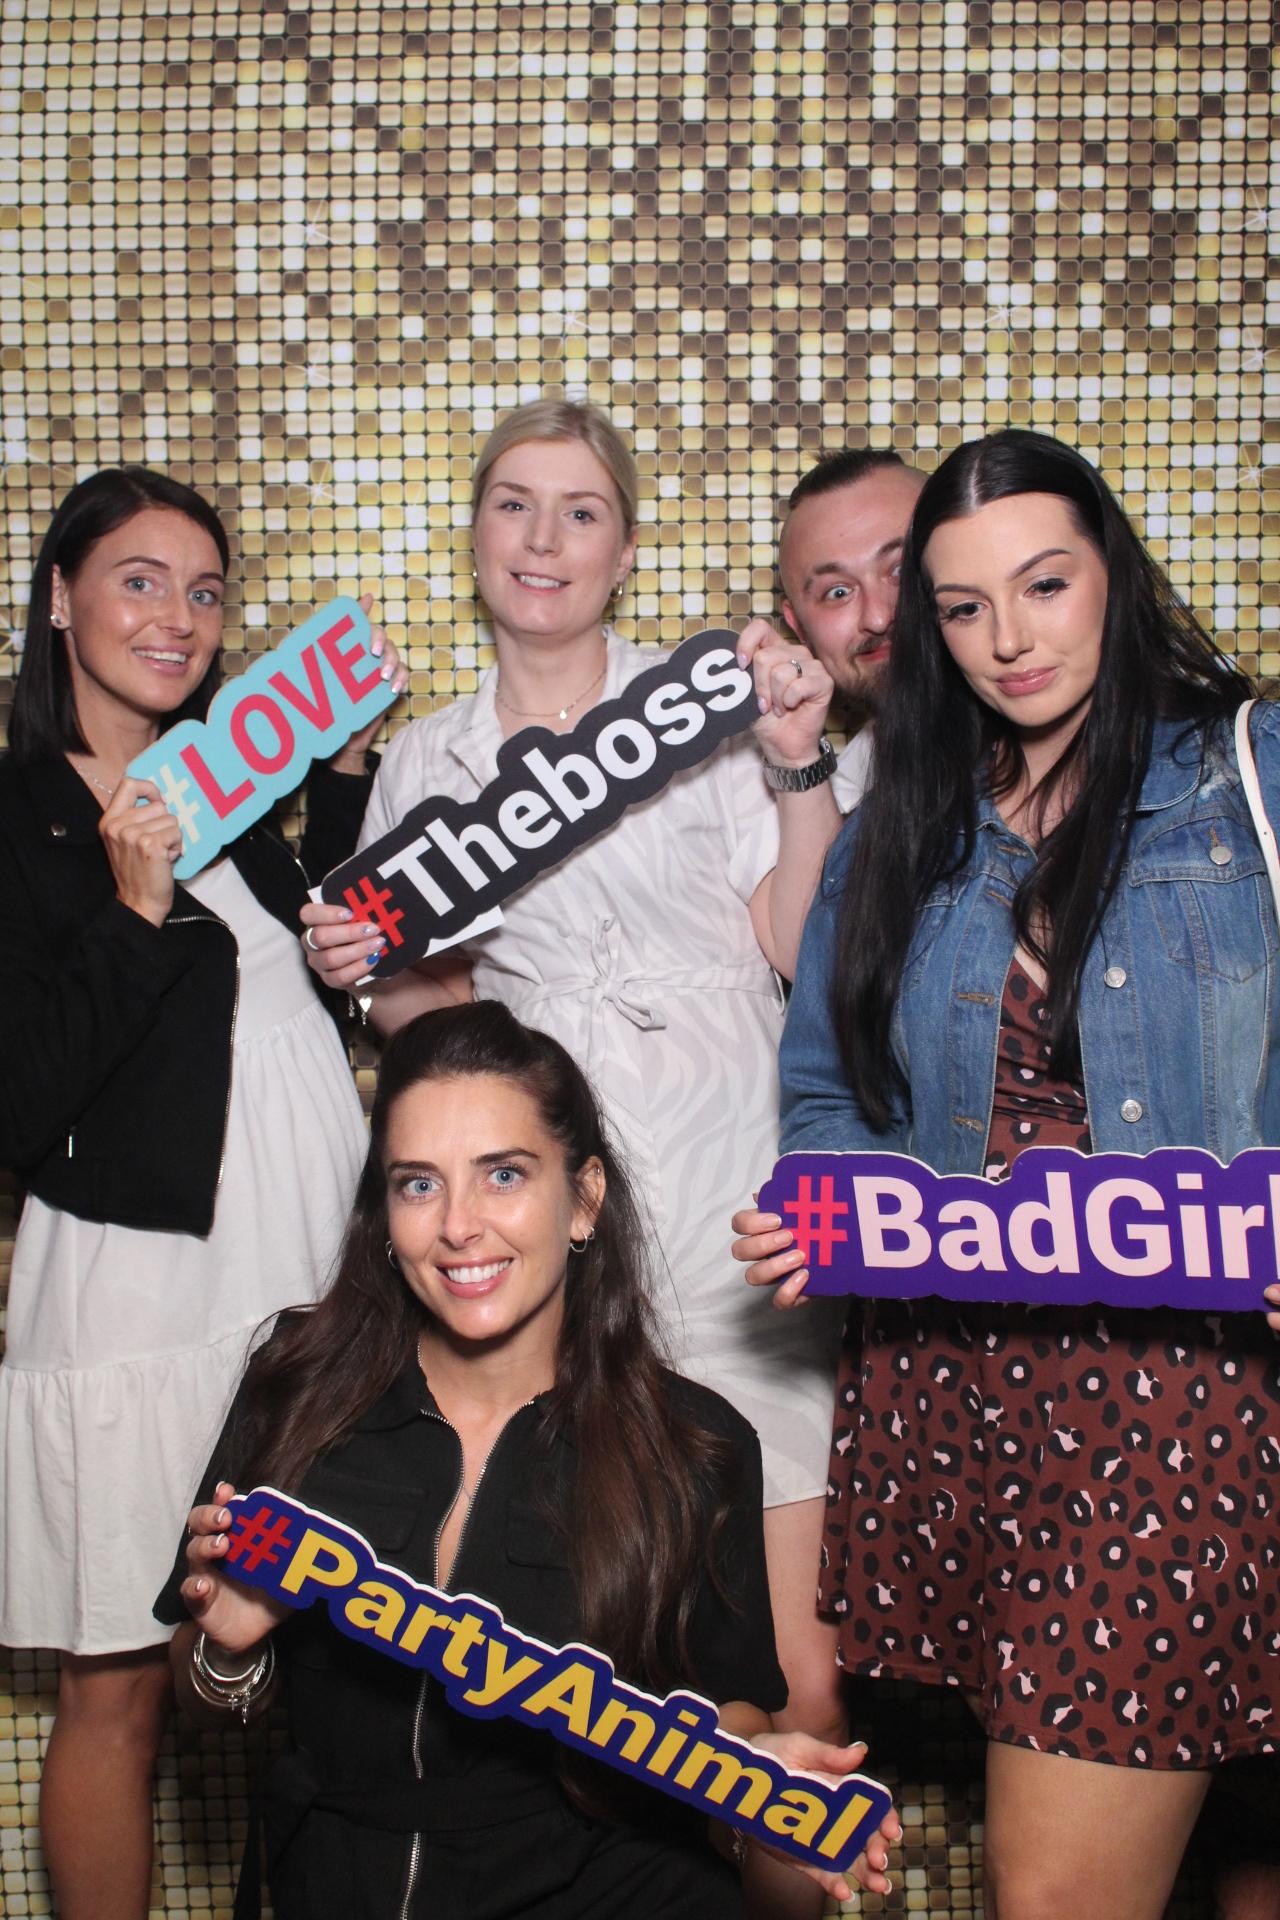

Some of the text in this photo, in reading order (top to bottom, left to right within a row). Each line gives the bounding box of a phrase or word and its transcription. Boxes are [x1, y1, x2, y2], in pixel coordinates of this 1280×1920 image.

[149, 614, 382, 853] #LOVE
[343, 648, 753, 958] #Theboss
[783, 1171, 1280, 1280] #BadGir
[226, 1506, 873, 1859] #PartyAnimal
